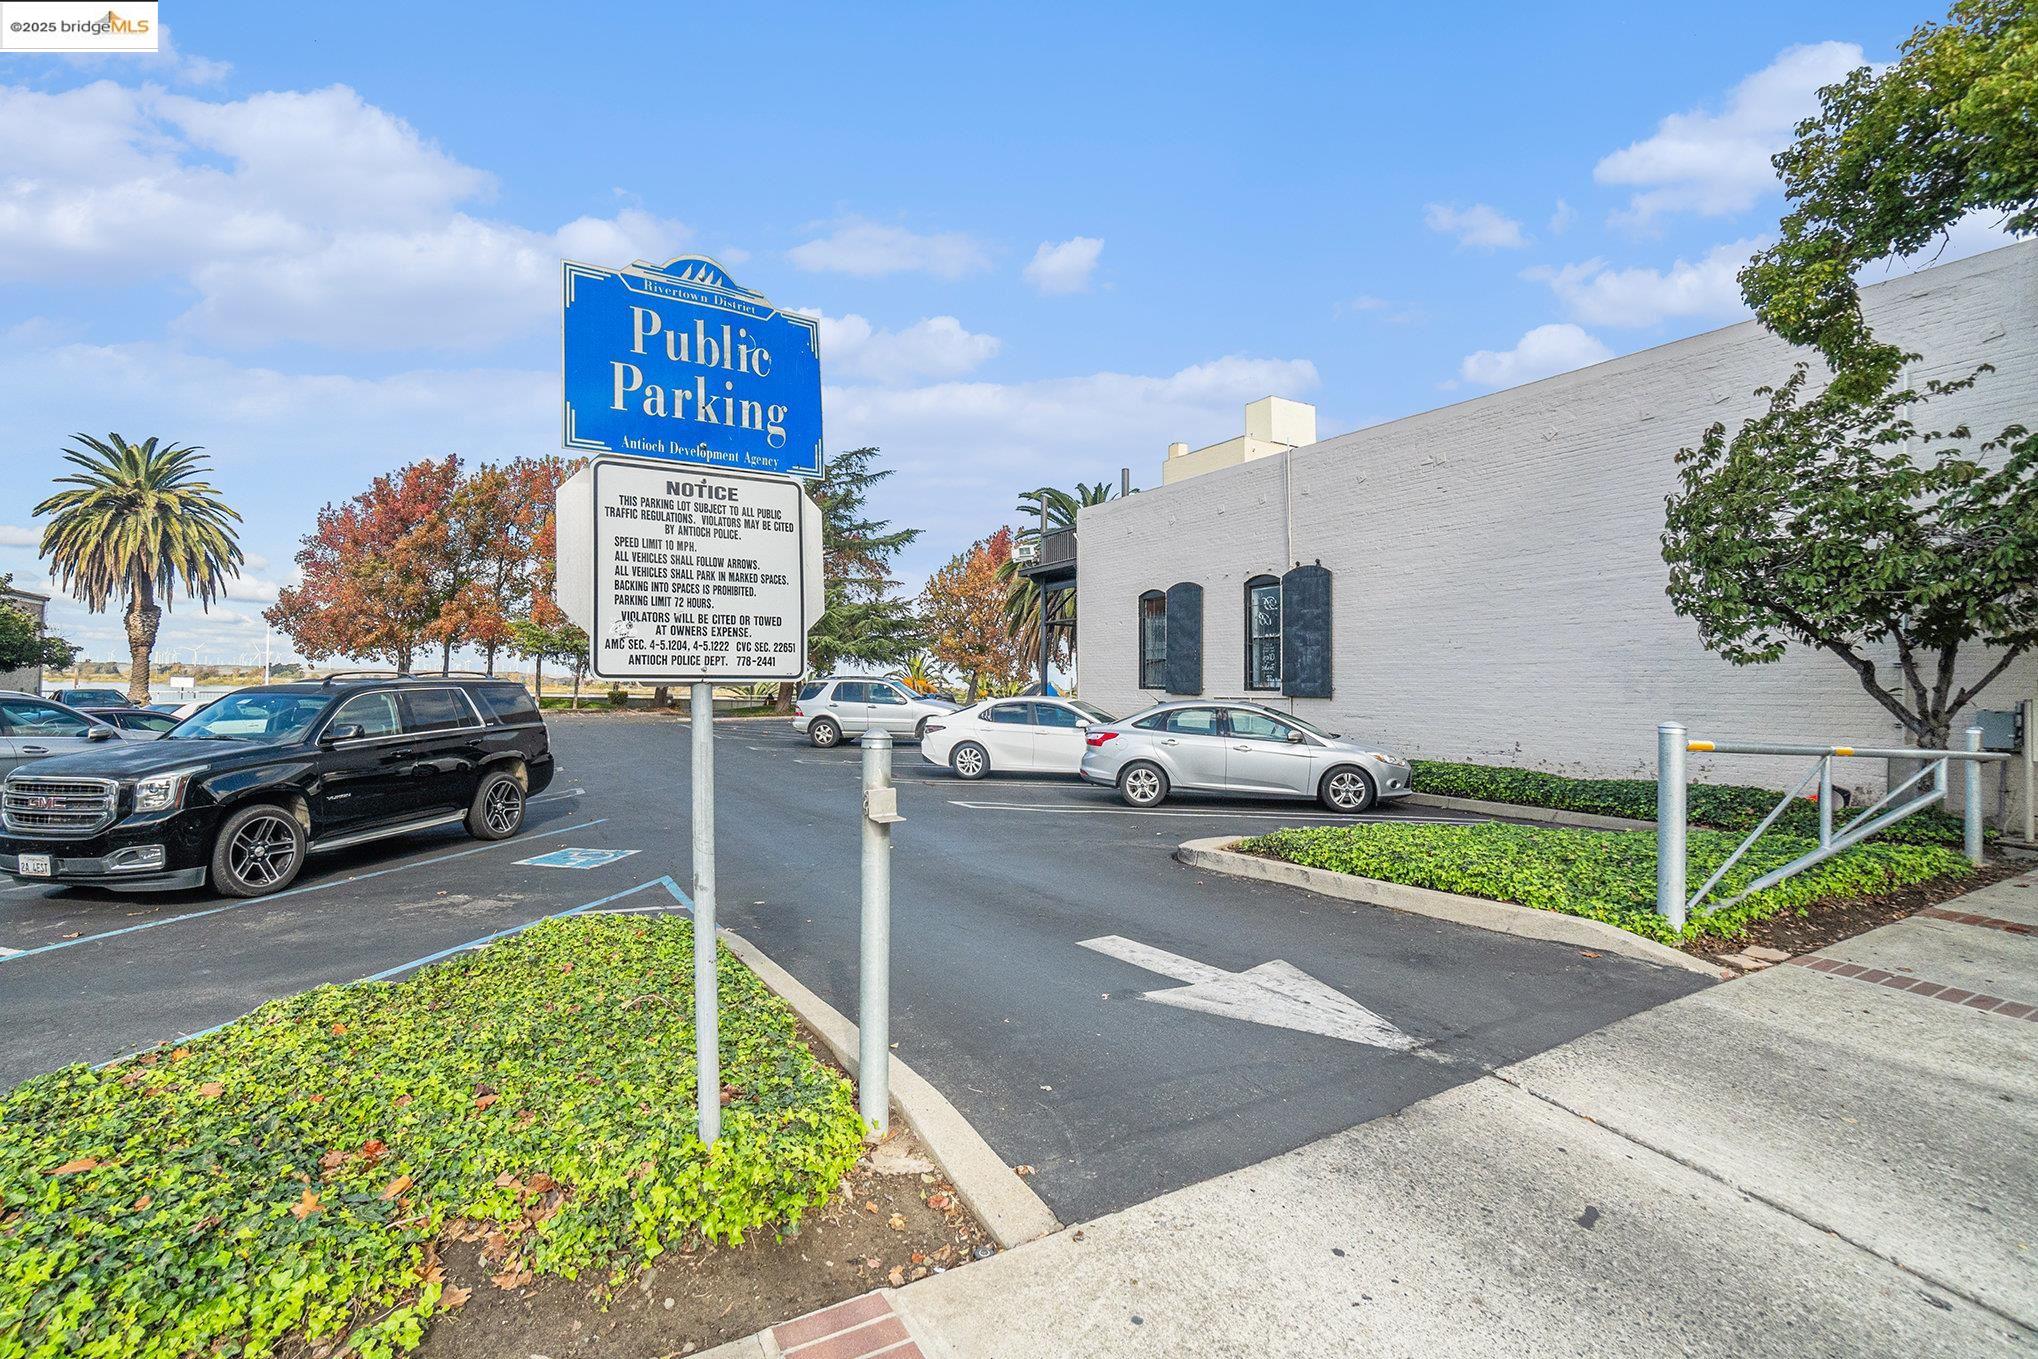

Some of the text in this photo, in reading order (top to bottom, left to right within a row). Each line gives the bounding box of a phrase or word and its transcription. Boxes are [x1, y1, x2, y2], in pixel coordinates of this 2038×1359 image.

[644, 279, 755, 315] Rivertown District
[630, 306, 772, 377] Public
[610, 361, 788, 449] Parking
[621, 435, 779, 471] Antioch Development Agency
[666, 481, 738, 501] NOTICE
[619, 495, 782, 520] THIS PARKING LOT SUBJECT TO ALL PUBLIC
[605, 506, 794, 533] TRAFFIC REGULATIONS. VIOLATORS MAY BE CITED
[665, 525, 741, 540] BY ANTIOCH POLICE.
[615, 536, 697, 552] SPEED LIMIT 10 MPH.
[615, 551, 760, 571] ALL VEHICLES SHALL FOLLOW ARROWS.
[615, 565, 789, 586] ALL VEHICLES SHALL PARK IN MARKED SPACES.
[615, 580, 756, 597] BACKING INTO SPACES IS PROHIBITED.
[615, 595, 714, 609] PARKING LIMIT 72 HOURS.
[621, 611, 782, 627] VIOLATORS WILL BE CITED OR TOWED
[655, 625, 751, 638] AT OWNERS EXPENSE.
[605, 639, 625, 650] AMC
[628, 639, 647, 651] SEC.
[693, 640, 729, 652] 4-5.1222
[736, 641, 751, 652] CVC
[754, 641, 771, 653] SEC.
[773, 642, 796, 653] 22651
[628, 654, 776, 667] ANTIOCH POLICE DEPT. 778-2441
